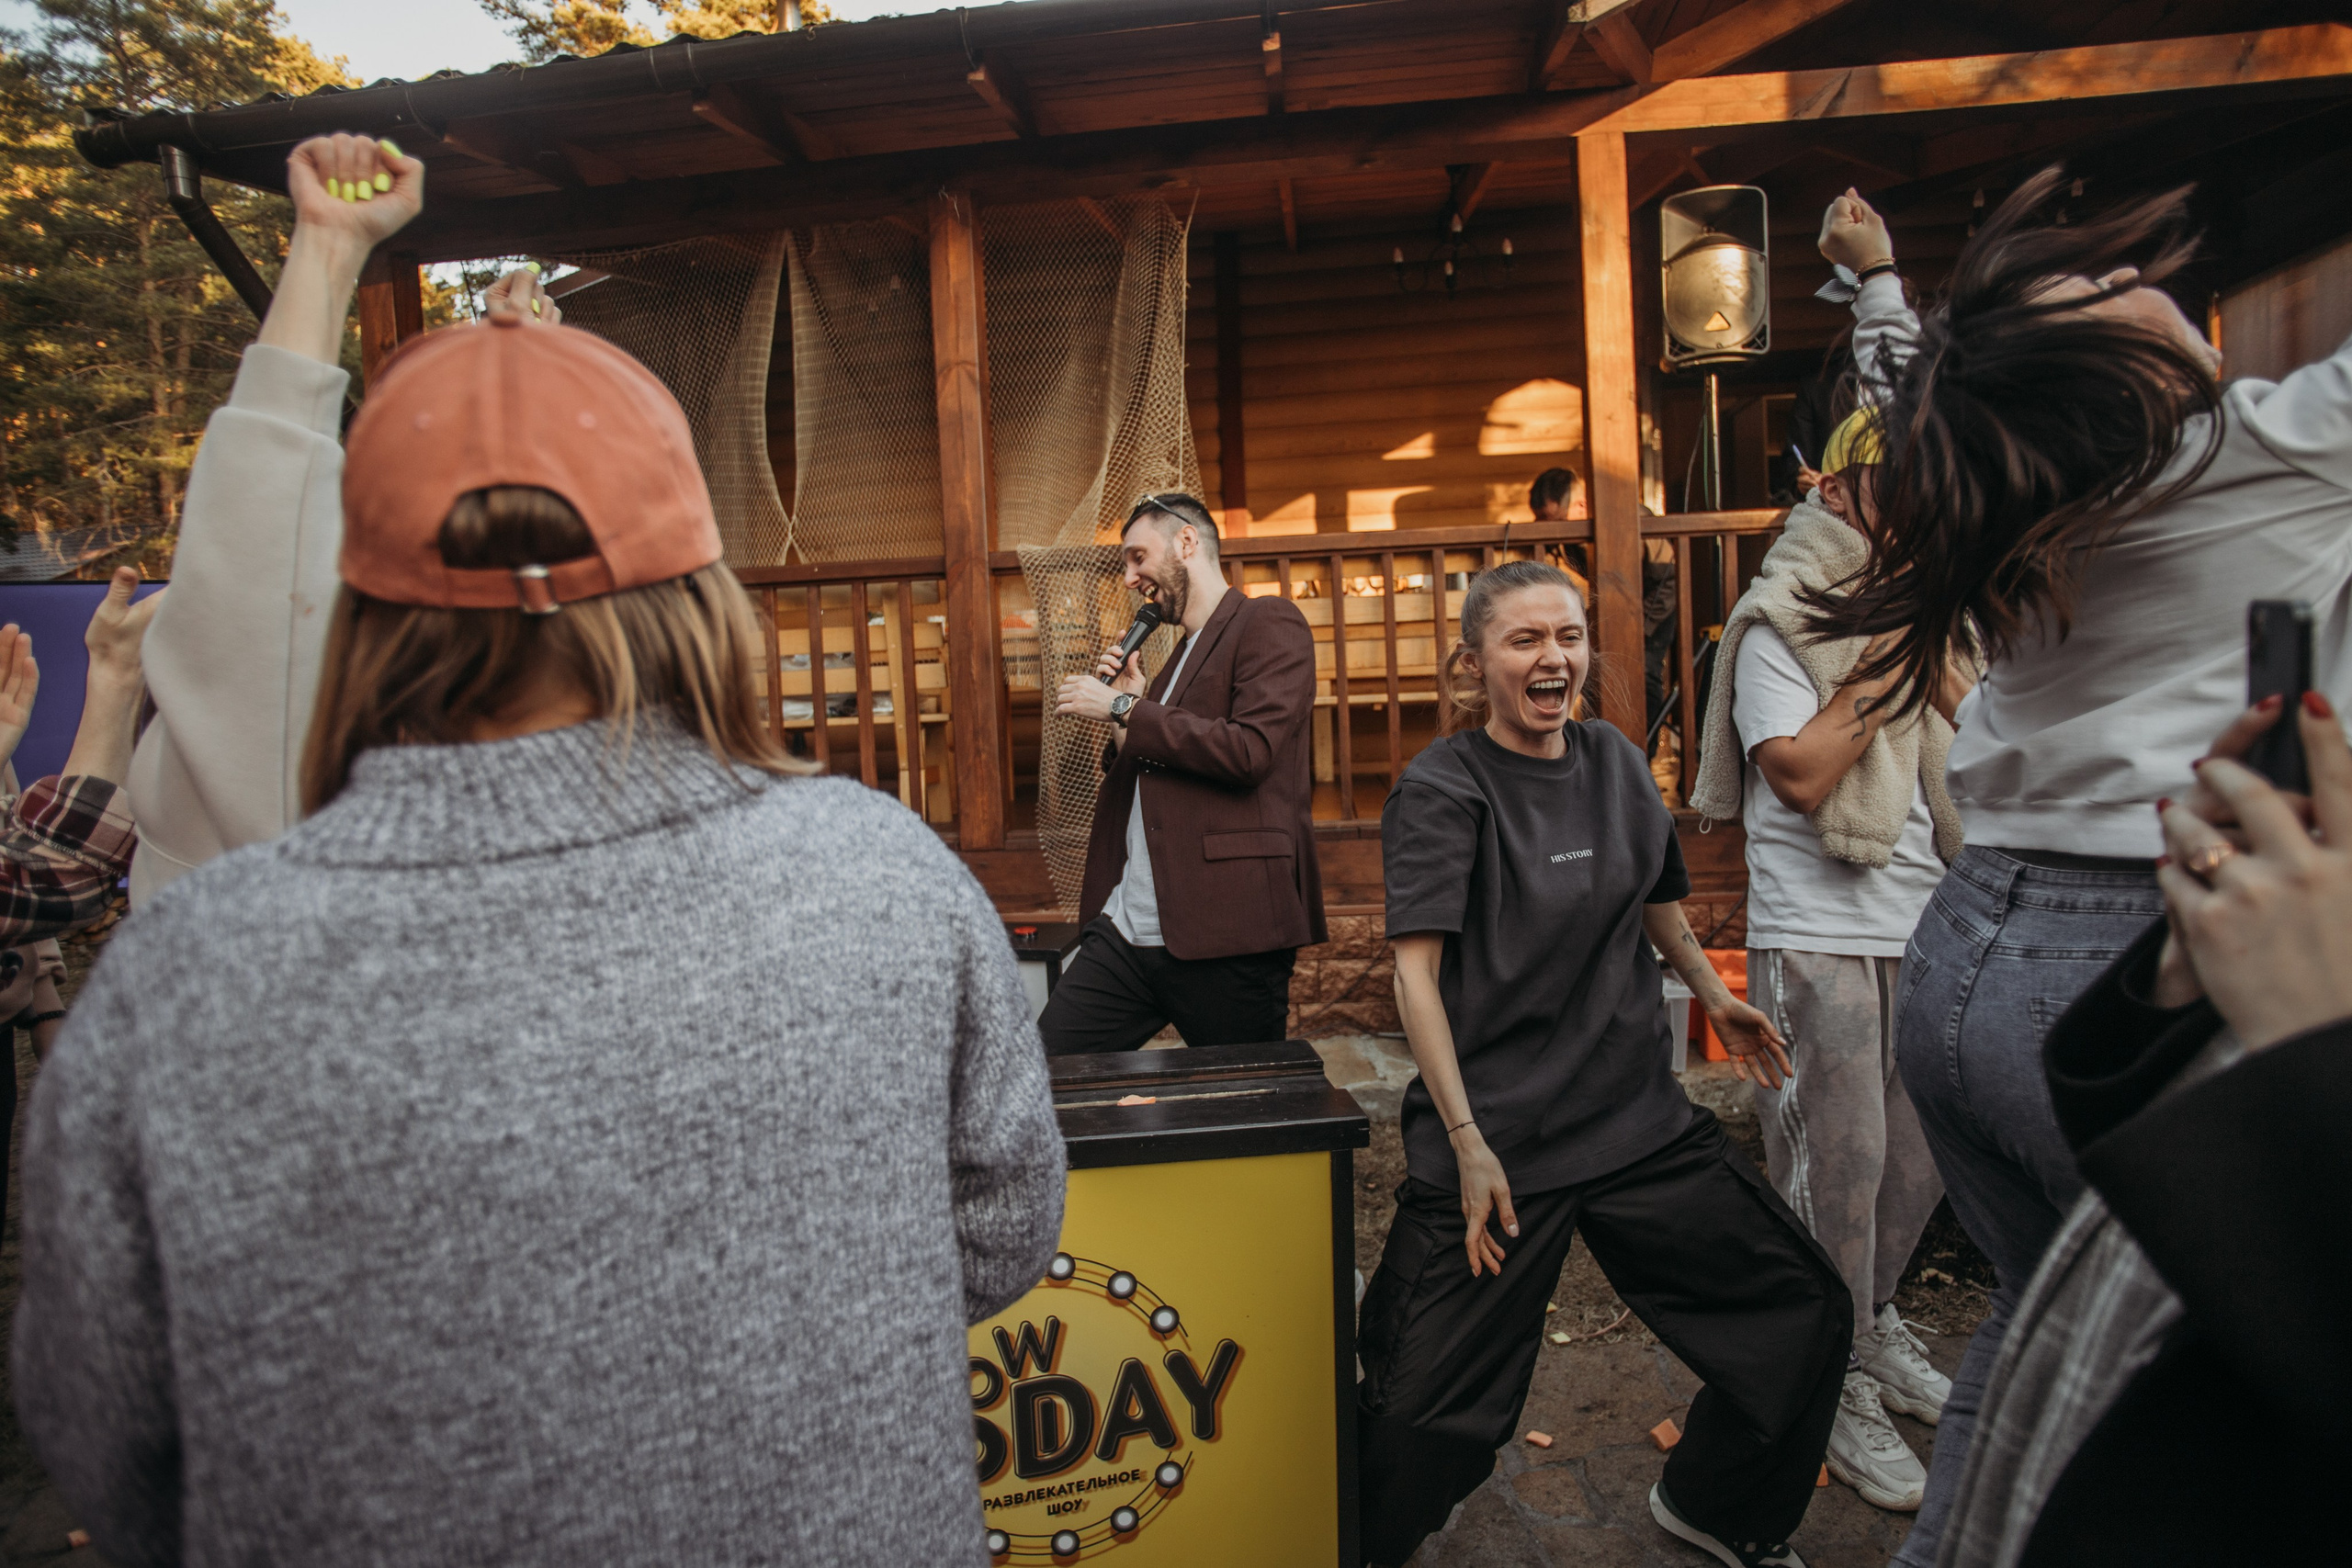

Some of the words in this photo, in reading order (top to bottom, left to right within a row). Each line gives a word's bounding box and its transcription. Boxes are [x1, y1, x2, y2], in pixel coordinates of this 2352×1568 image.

[1566, 848, 1593, 861] STORY
[983, 1468, 1141, 1511] РАЗВЛЕКАТЕЛЬНОЕ
[1046, 1497, 1083, 1517] ШОУ
